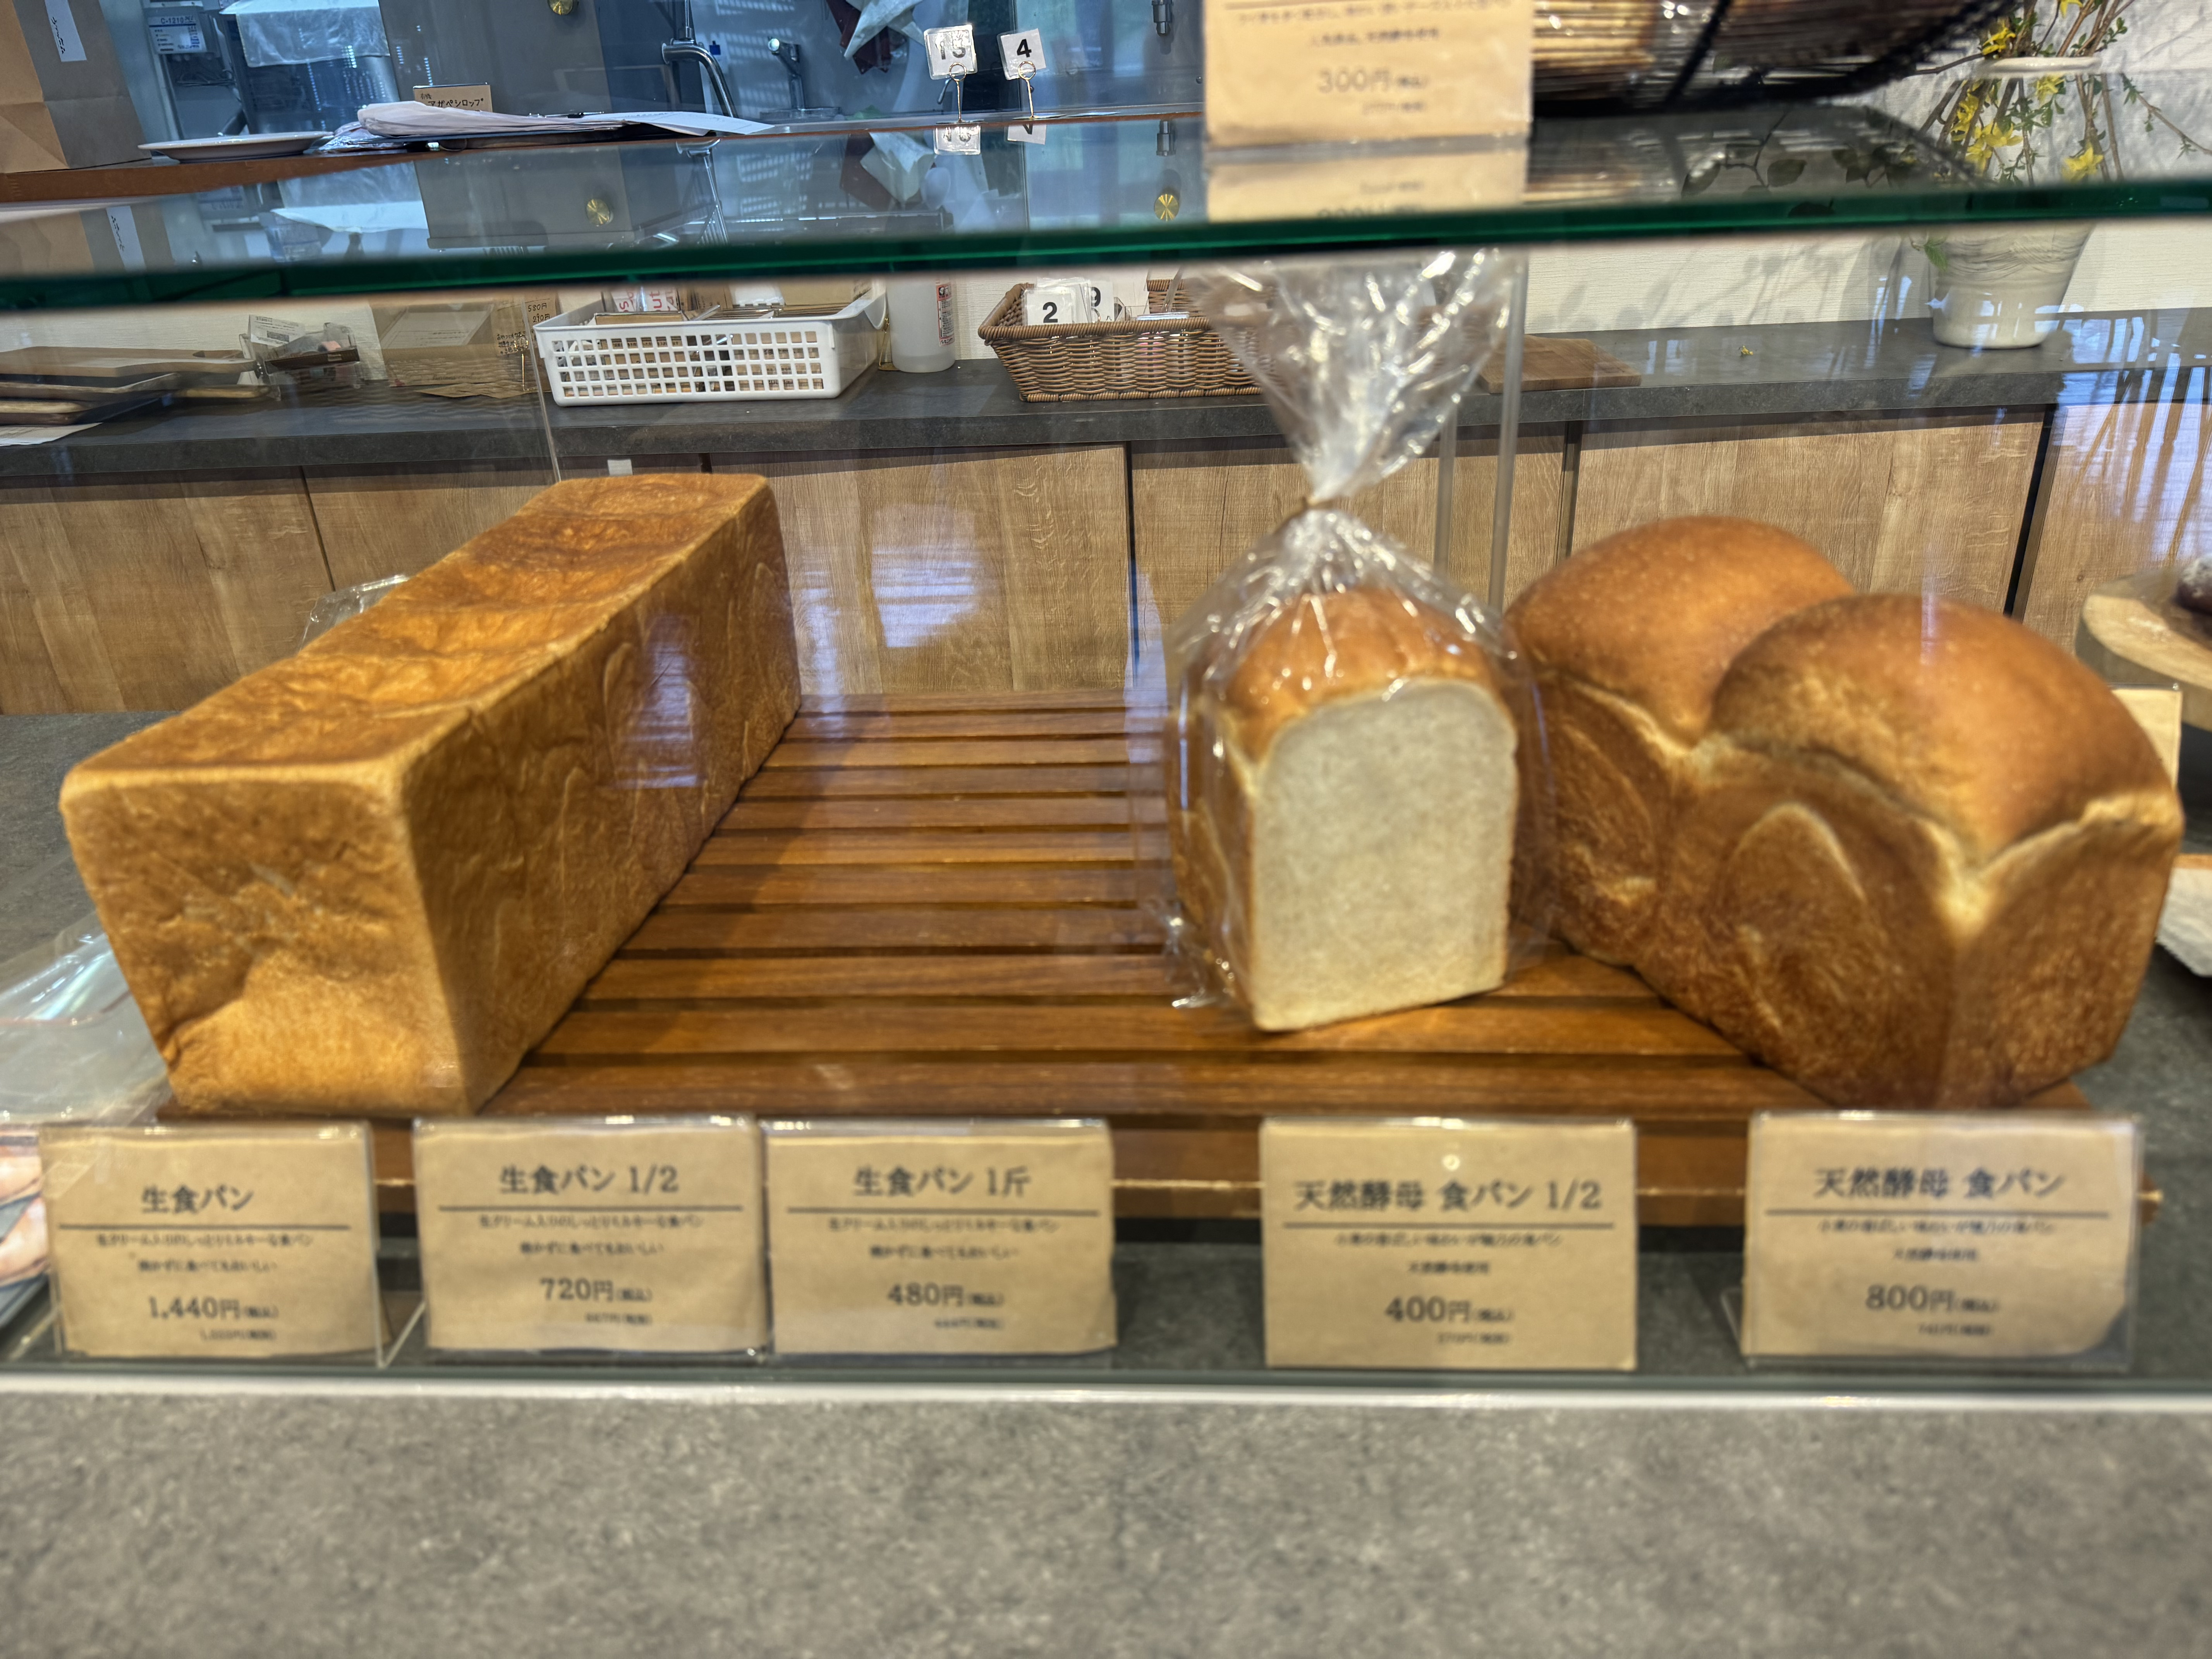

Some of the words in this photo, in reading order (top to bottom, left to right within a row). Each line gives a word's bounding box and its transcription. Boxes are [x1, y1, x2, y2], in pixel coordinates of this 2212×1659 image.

[1017, 38, 1032, 58] 4
[528, 302, 547, 312] 580円
[533, 313, 550, 323] 290円
[1042, 302, 1058, 323] 2
[500, 1164, 616, 1195] 生食パン
[629, 1163, 678, 1195] 1/2
[853, 1164, 975, 1197] 生食パン
[986, 1165, 1032, 1197] 1斤
[1813, 1166, 1949, 1200] 天然酵母
[1963, 1166, 2064, 1199] 食パン
[141, 1184, 254, 1215] 生食パン
[1293, 1179, 1425, 1211] 天然酵母
[1437, 1178, 1533, 1212] 食パン
[1546, 1178, 1602, 1211] 1/2
